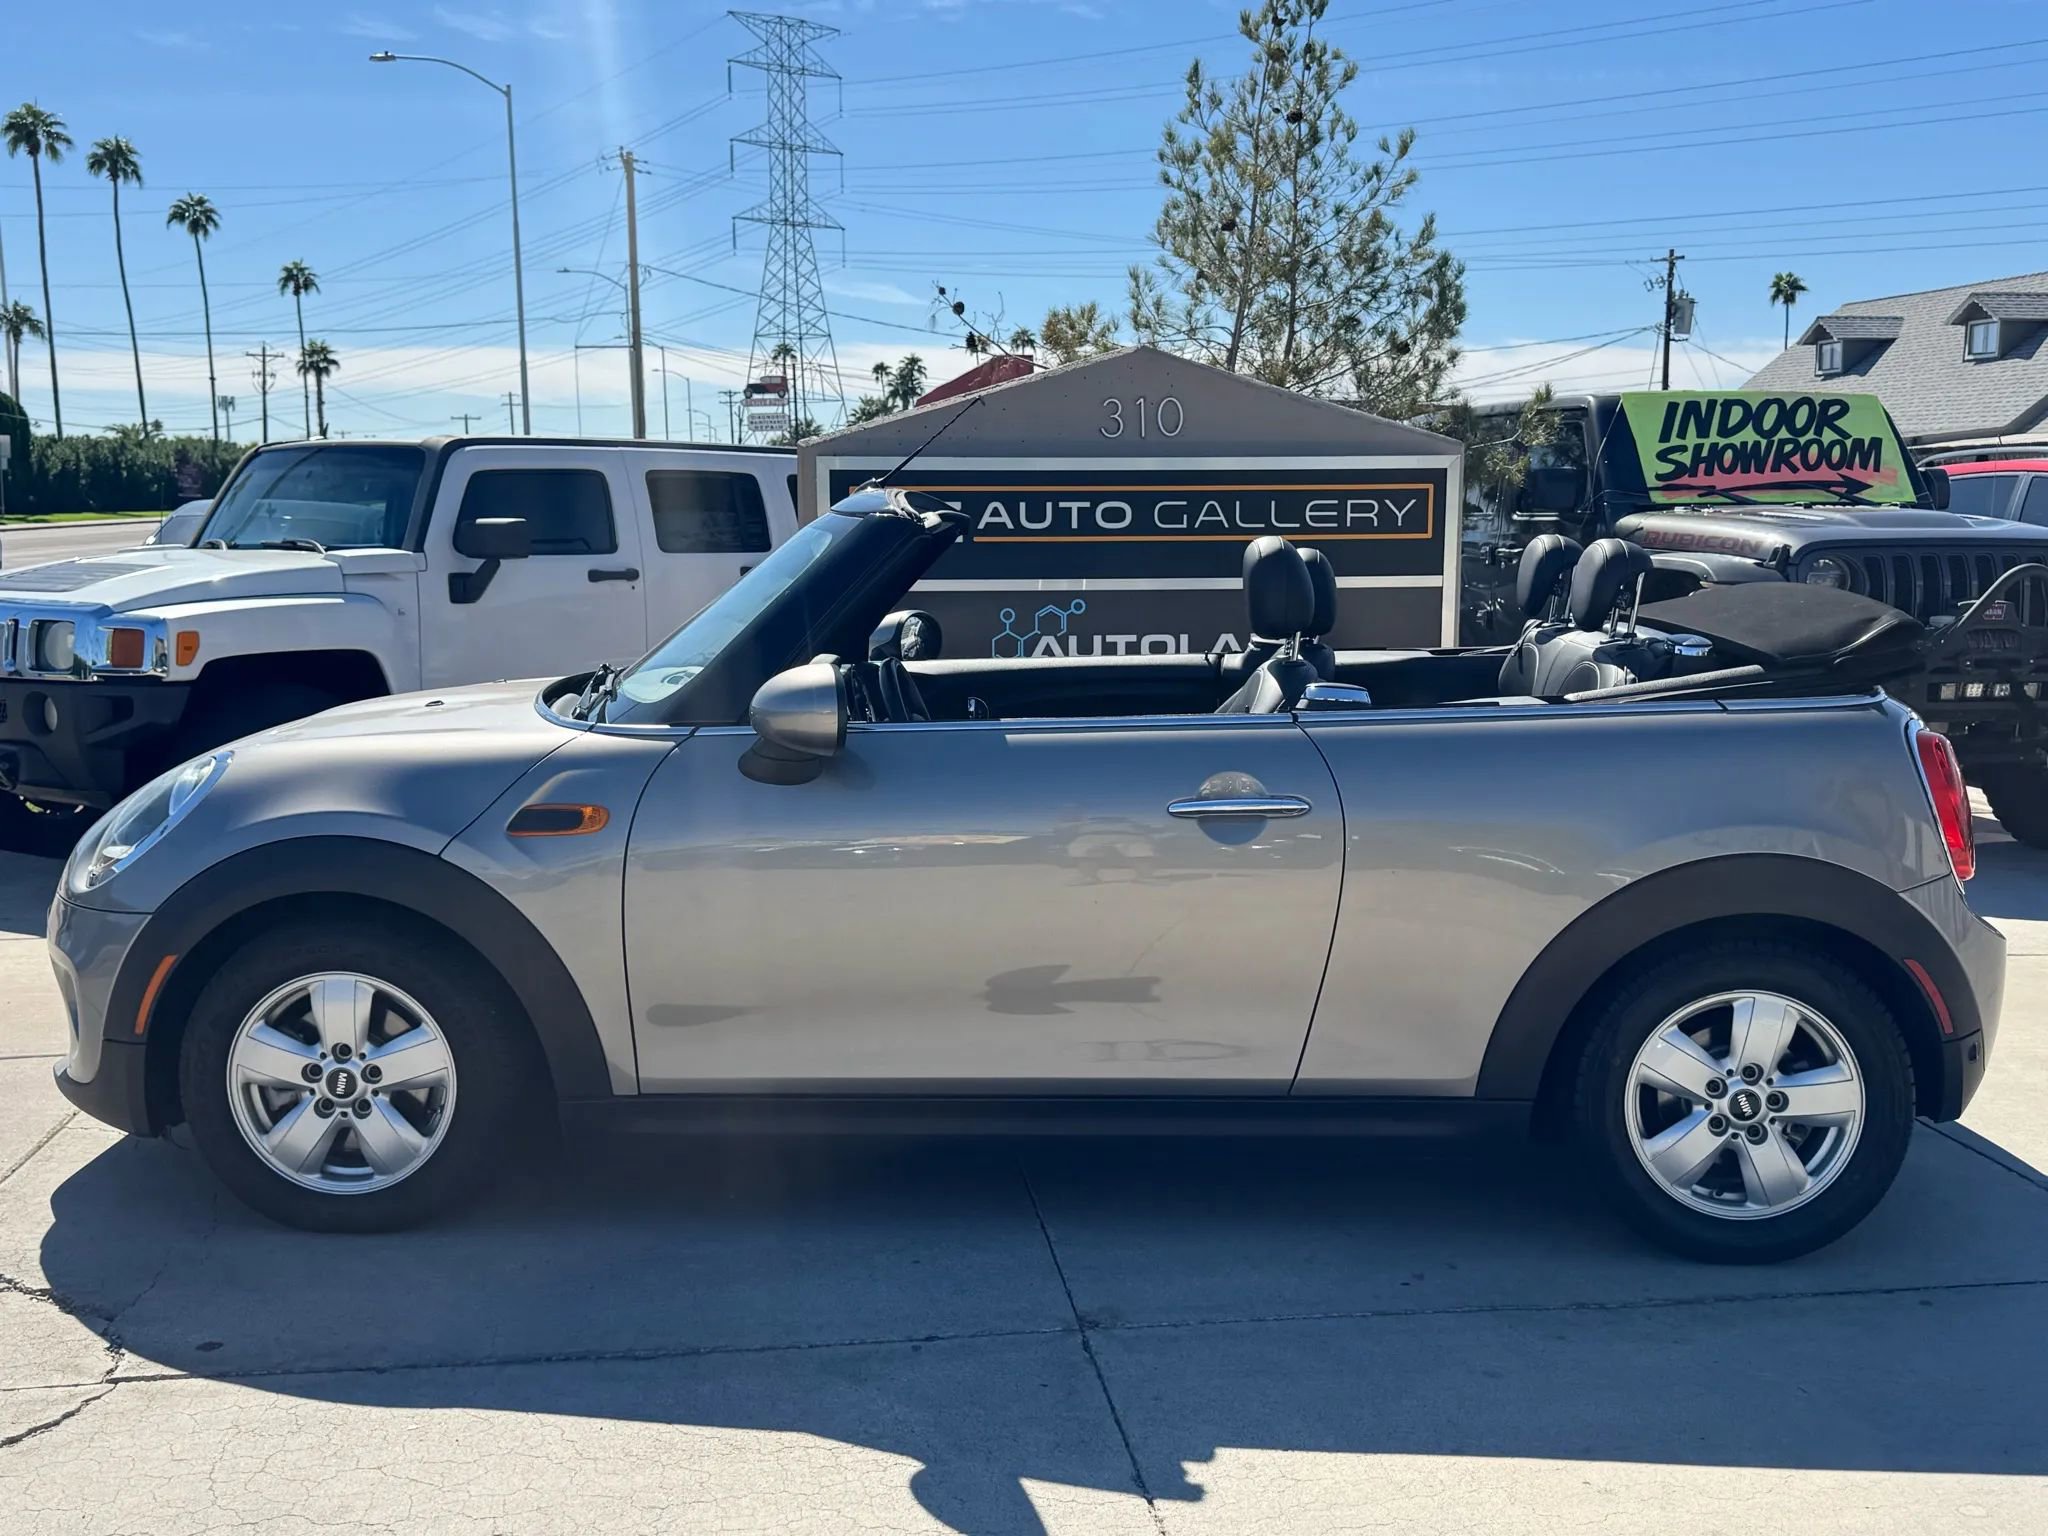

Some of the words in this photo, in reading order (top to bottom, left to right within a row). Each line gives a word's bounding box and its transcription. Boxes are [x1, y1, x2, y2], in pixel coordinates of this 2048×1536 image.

[1100, 396, 1185, 438] 310
[1658, 396, 1852, 443] INDOOR
[1655, 436, 1882, 482] SHOWROOM
[976, 501, 1132, 530] AUTO
[1153, 498, 1417, 529] GALLERY
[1643, 531, 1762, 553] RUBICON
[1031, 633, 1256, 658] AUTOLA
[336, 1072, 347, 1093] MINI
[1737, 1094, 1753, 1117] MINI
